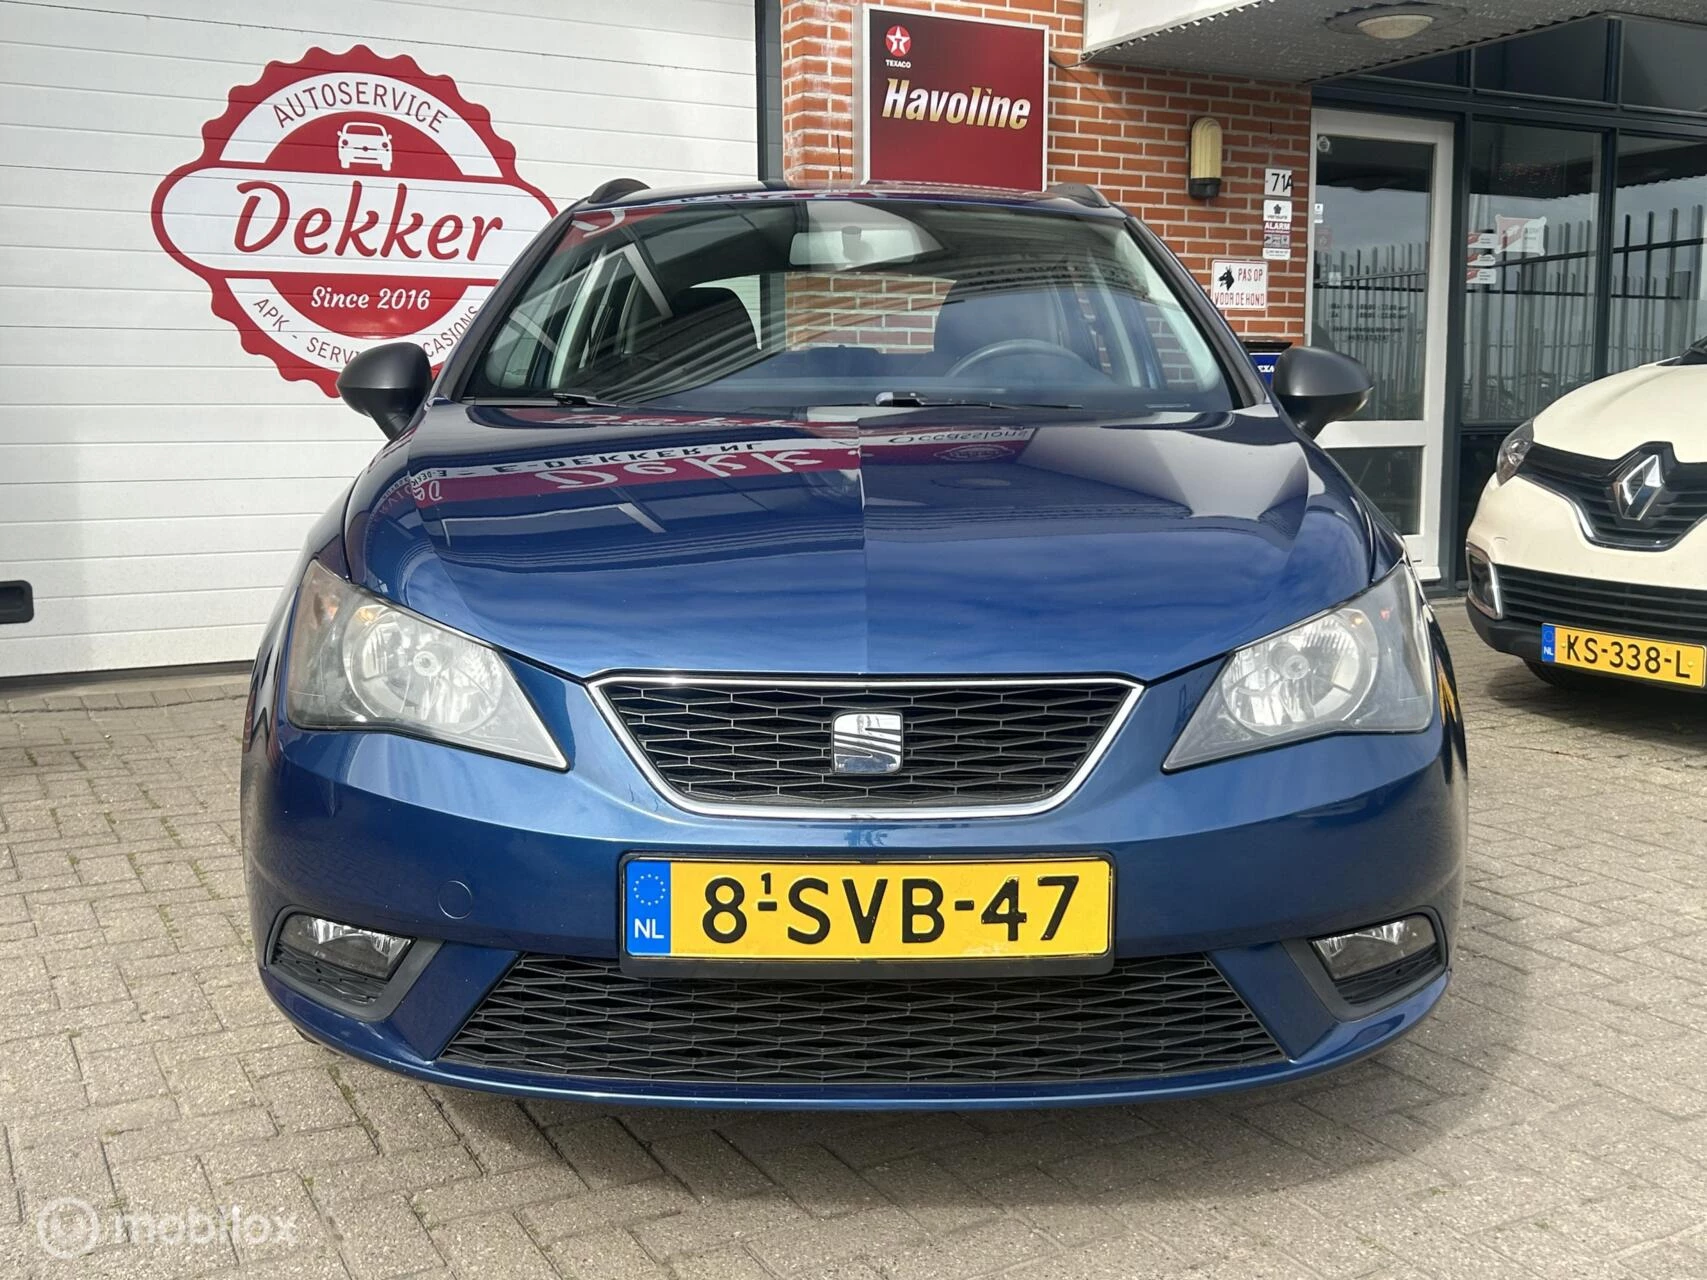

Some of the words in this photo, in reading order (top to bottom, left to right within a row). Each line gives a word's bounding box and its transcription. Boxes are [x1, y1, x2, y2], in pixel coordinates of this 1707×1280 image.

[885, 59, 912, 69] TEXACO
[273, 81, 448, 134] AUTOSERVICE
[882, 78, 1031, 130] Havoline
[234, 180, 504, 262] Dekker
[1264, 221, 1291, 231] ALARM
[1238, 268, 1252, 282] PAS
[1254, 268, 1263, 282] OP
[310, 286, 370, 310] Since
[377, 288, 431, 311] 2016
[1214, 292, 1234, 306] VOOR
[1235, 292, 1245, 306] DE
[1246, 293, 1265, 306] HOND
[253, 298, 290, 332] APK
[1543, 647, 1554, 656] NL
[1566, 634, 1691, 679] KS-338-L
[634, 918, 665, 940] NL
